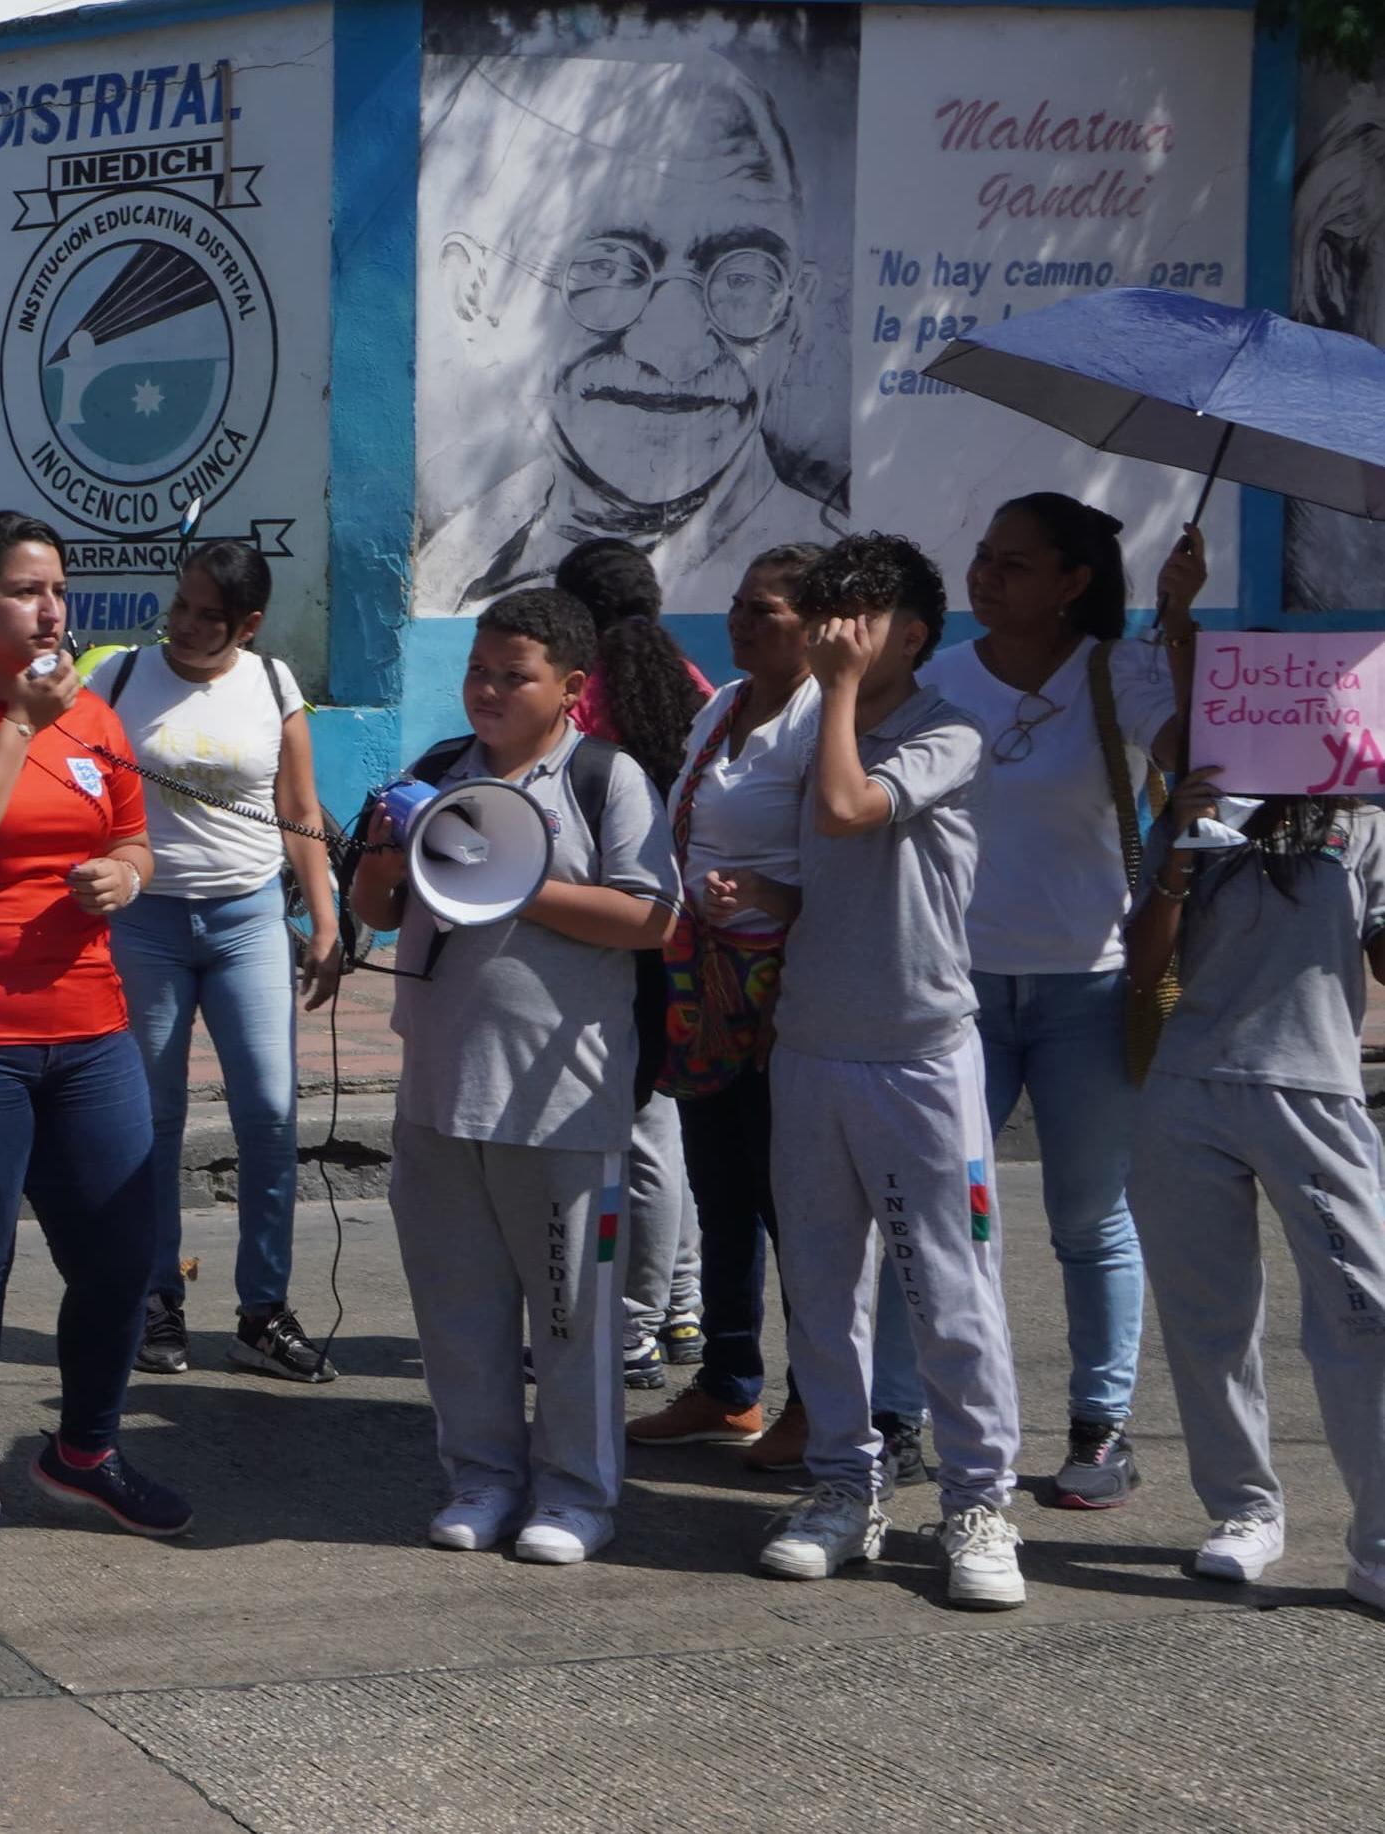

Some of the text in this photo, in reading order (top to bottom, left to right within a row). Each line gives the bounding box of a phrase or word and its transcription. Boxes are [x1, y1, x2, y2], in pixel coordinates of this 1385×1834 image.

[934, 97, 1177, 152] Mahatma
[60, 145, 214, 188] INEDICH
[975, 167, 1154, 230] Gandhi
[17, 204, 258, 333] INSTITUCIÓN EDUCATIVA DISTRITAL
[932, 251, 991, 296] hay
[872, 304, 901, 343] la
[30, 420, 249, 525] INOCENCIO CHINCÁ
[66, 545, 187, 571] ARRANQU
[1208, 646, 1361, 690] Justicia
[1306, 728, 1385, 794] YA
[547, 1202, 569, 1340] INEDICH
